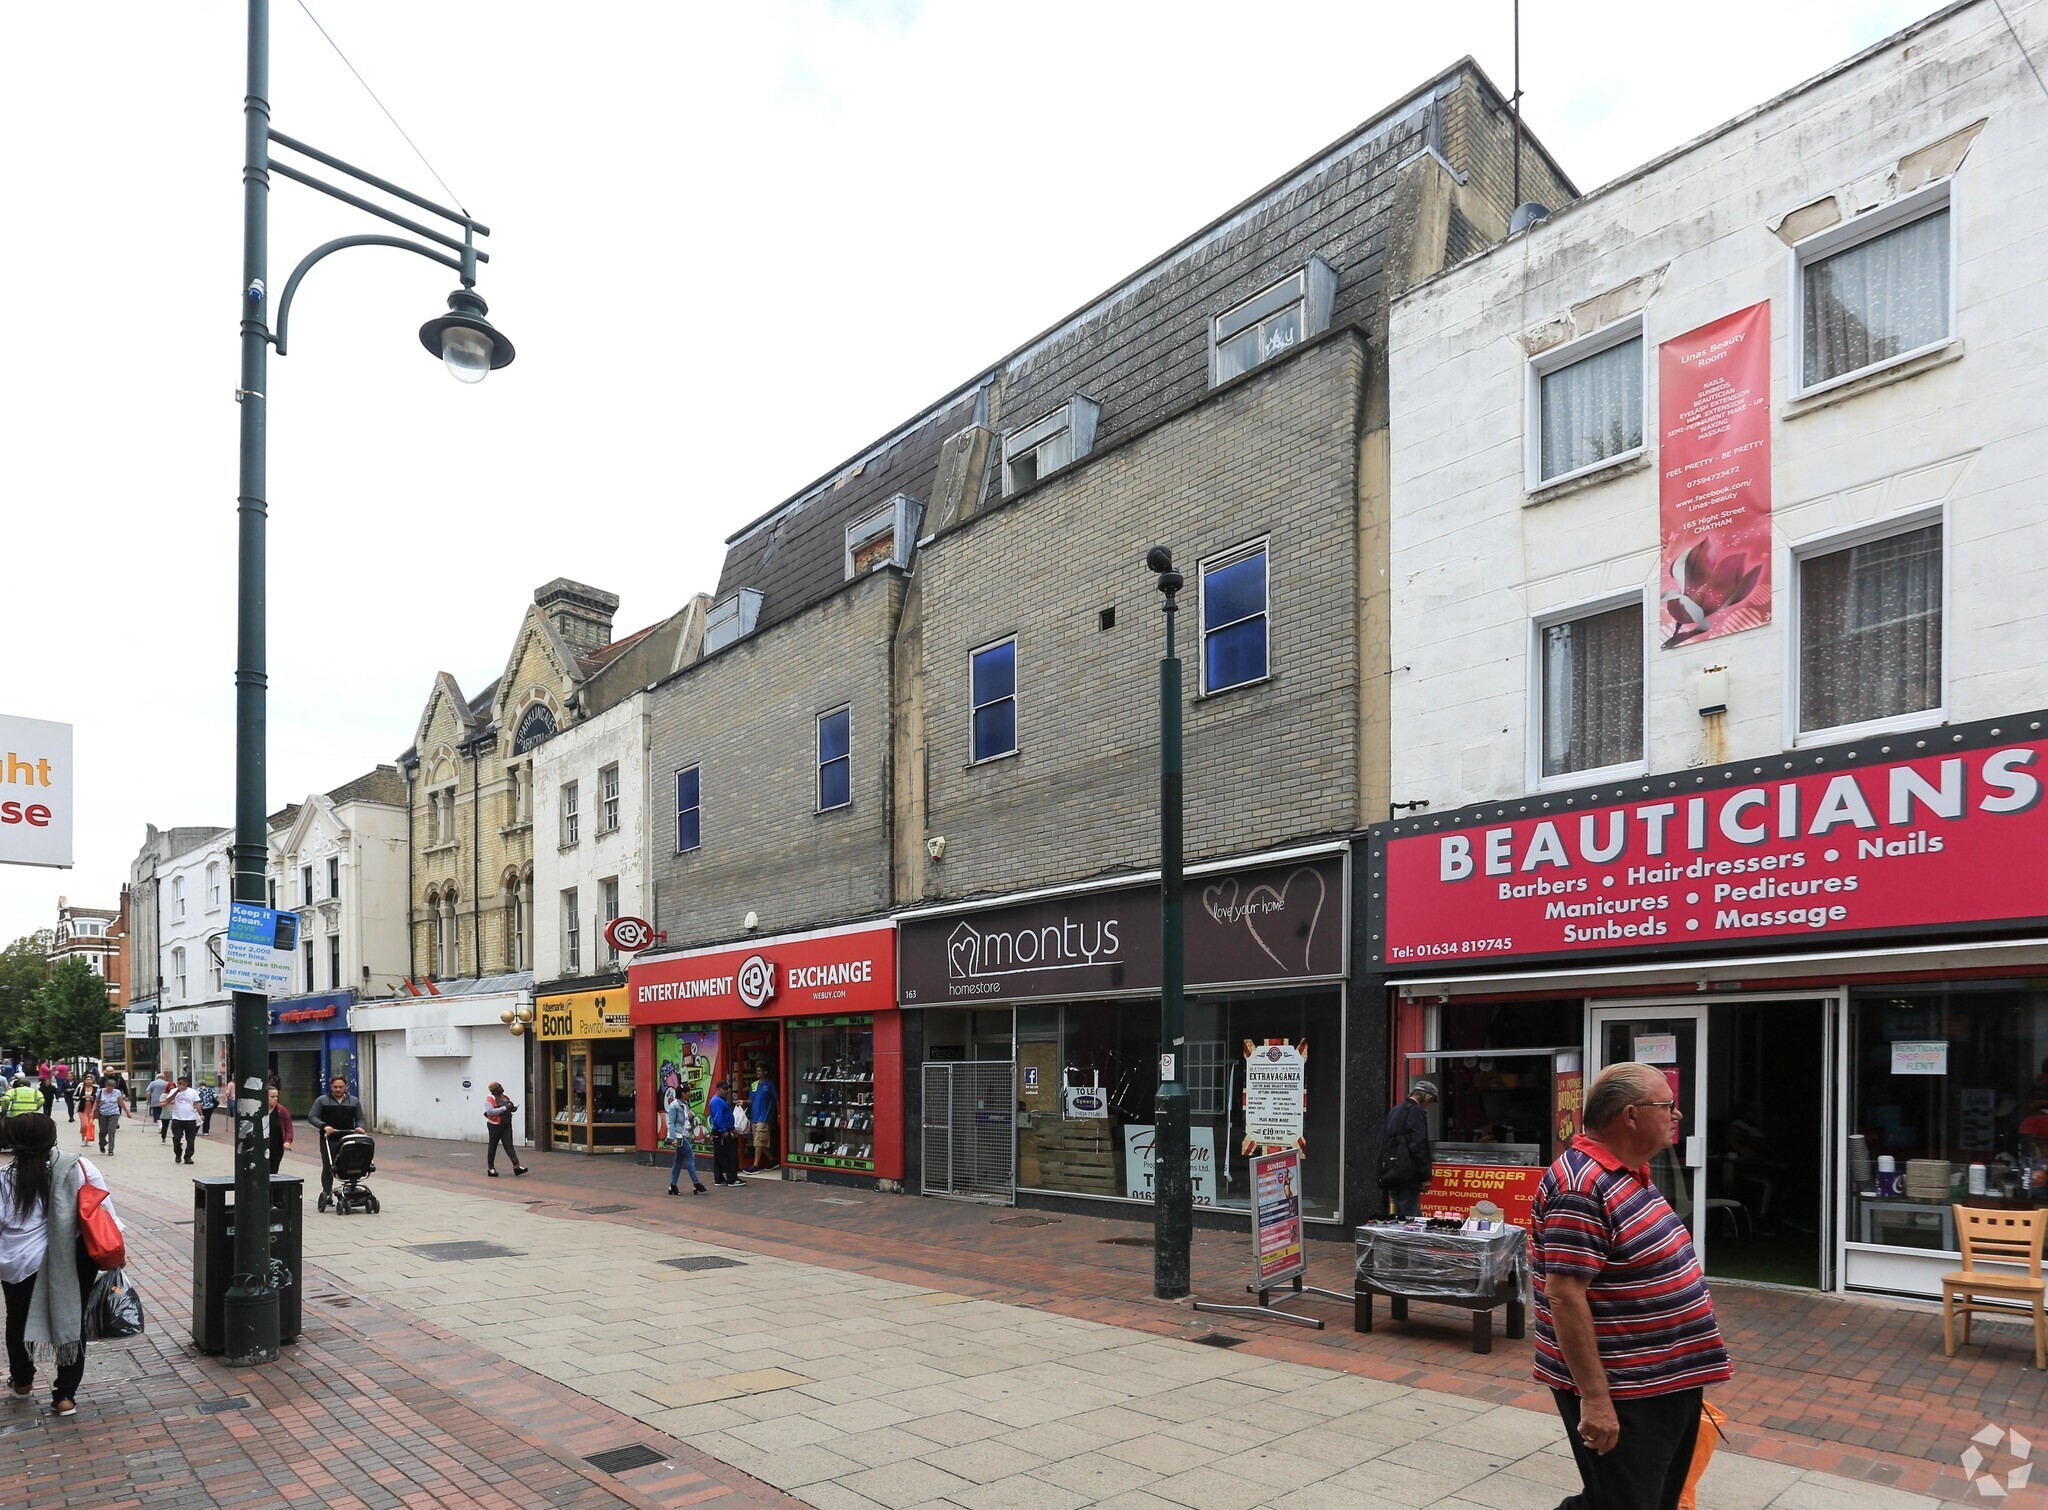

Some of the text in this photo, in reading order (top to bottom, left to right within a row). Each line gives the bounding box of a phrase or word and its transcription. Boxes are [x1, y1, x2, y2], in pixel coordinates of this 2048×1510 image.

[1681, 333, 1745, 364] Linas Beauty
[1698, 350, 1727, 367] Room
[1698, 381, 1731, 399] SUNBEDS
[1703, 376, 1725, 389] NAILS
[1679, 388, 1751, 420] EYELASH EXTENSION
[1693, 388, 1736, 408] BEAUTICIAN
[1667, 412, 1726, 438] SEMI-PERMANENT
[1728, 404, 1747, 415] MAKE
[1754, 397, 1764, 406] UP
[1686, 398, 1745, 424] HAIR EXTENSION
[1698, 424, 1732, 441] MASSAGE
[1700, 417, 1729, 433] WAXING
[1666, 467, 1684, 479] FEEL
[1684, 457, 1714, 472] PRETTY
[1721, 450, 1733, 460] BE
[1734, 439, 1764, 455] PRETTY
[1686, 465, 1740, 489] 07594723472
[1675, 478, 1753, 509] www.facebook.com/
[1682, 506, 1746, 531] 165 Hight Street
[1694, 517, 1733, 534] CHATHAM
[0, 752, 52, 788] ht
[1440, 748, 2039, 882] BEAUTICIANS
[1499, 830, 1944, 900] Barbers Hairdressers Nails
[1545, 875, 1858, 920] Manicures Pedicures
[232, 906, 271, 919] Keep it
[1213, 895, 1285, 922] love your home
[231, 923, 256, 932] LOVE
[232, 915, 263, 926] clean.
[1563, 905, 1847, 942] Sunbeds Massage
[230, 931, 272, 943] MEDWAY
[227, 950, 267, 961] litter bins.
[228, 943, 271, 955] Over 2,000
[1392, 937, 1512, 958] Tel: 01634 819745
[227, 956, 253, 966] Please
[270, 962, 292, 971] them.
[638, 976, 734, 1003] ENTERTAINMENT
[788, 960, 872, 989] EXCHANGE
[949, 981, 1001, 995] homestore
[812, 990, 846, 1000] WEBUY.COM
[905, 989, 917, 999] 163
[542, 1010, 573, 1036] Bond
[1896, 1053, 1921, 1061] SHOP
[1906, 1062, 1936, 1071] RENT
[1249, 1072, 1301, 1081] EXTRAVAGANZA
[1262, 1128, 1274, 1136] £10
[1199, 1165, 1211, 1173] Ltd.
[1267, 1161, 1287, 1172] SUNBEDS
[1444, 1178, 1505, 1189] IN TOWN
[1464, 1170, 1526, 1181] BURGER
[1449, 1191, 1489, 1199] POUNDER
